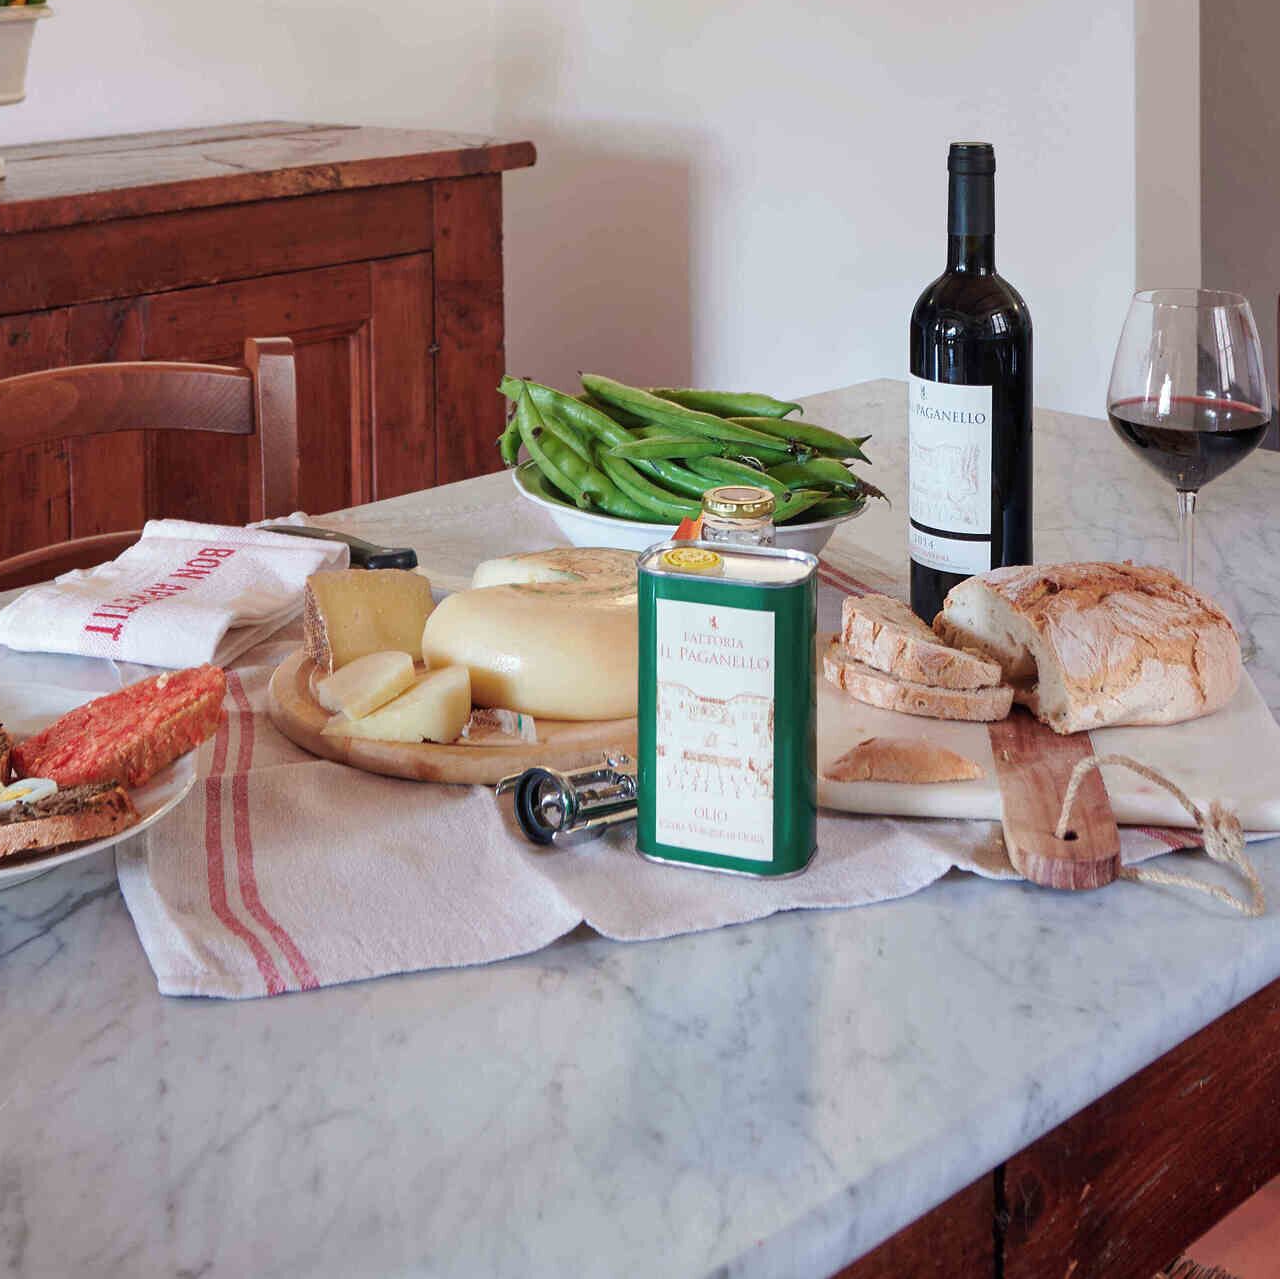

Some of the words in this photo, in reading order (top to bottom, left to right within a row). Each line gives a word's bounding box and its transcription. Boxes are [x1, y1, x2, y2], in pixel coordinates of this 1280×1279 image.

[916, 404, 986, 425] PAGANELLO
[169, 547, 236, 580] BON
[682, 631, 744, 649] FATTORIA
[679, 646, 770, 672] PAGANELLO
